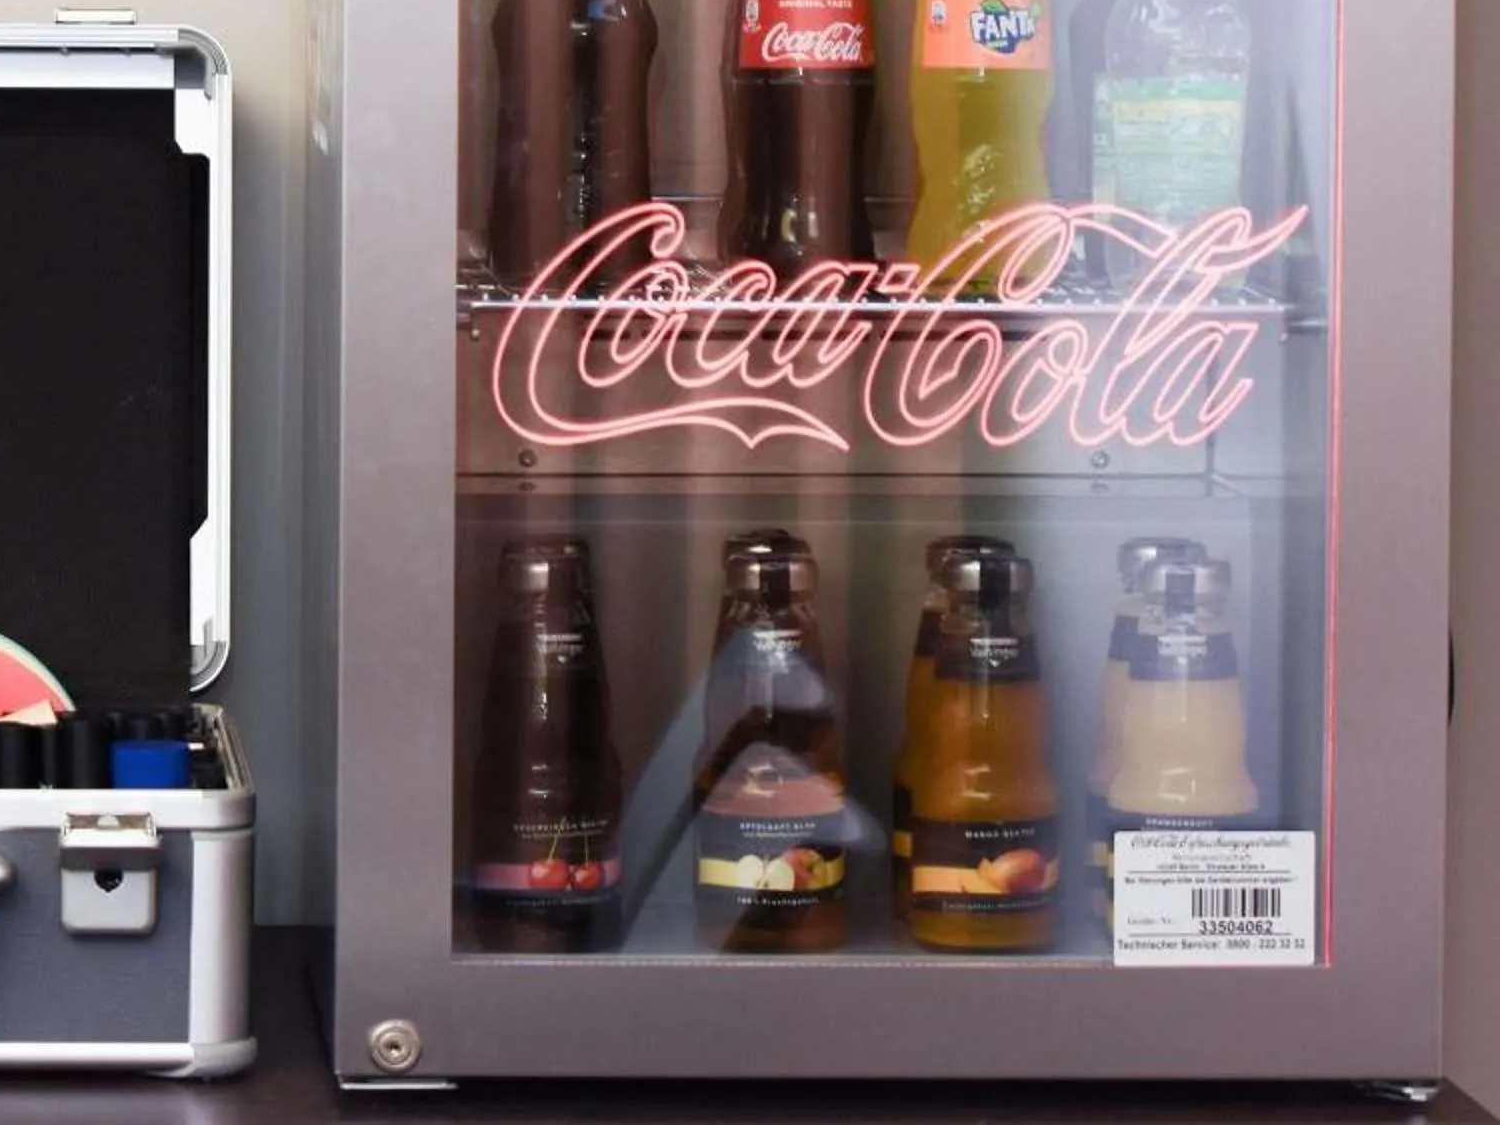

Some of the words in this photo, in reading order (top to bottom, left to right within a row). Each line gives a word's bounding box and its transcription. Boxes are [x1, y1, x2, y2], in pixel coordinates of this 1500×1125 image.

[492, 202, 1308, 452] Coca-Cola
[1199, 920, 1273, 935] 33504062
[1118, 939, 1178, 950] Technischer
